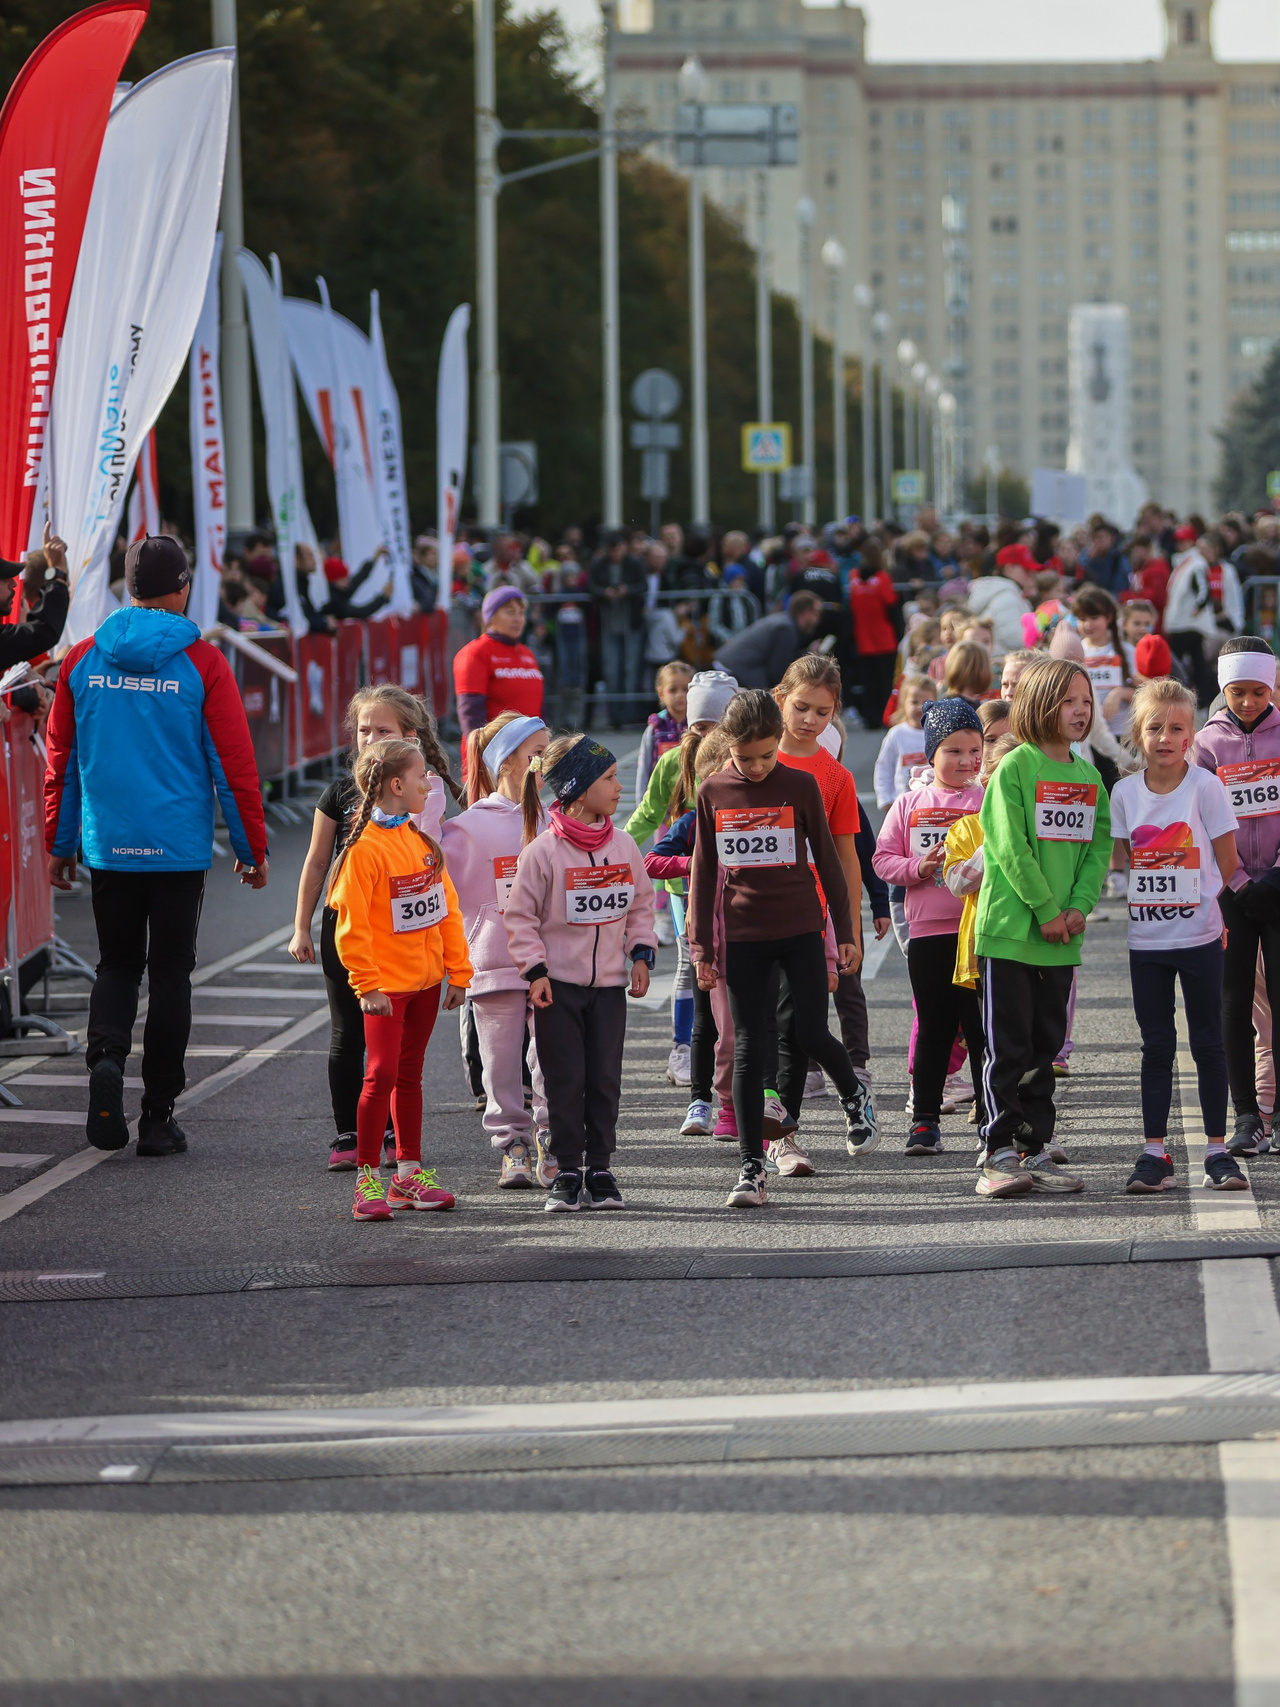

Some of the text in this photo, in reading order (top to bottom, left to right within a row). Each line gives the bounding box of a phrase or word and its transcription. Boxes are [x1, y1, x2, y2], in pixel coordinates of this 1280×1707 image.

[88, 675, 180, 694] RUSSIA
[1231, 785, 1279, 806] 3168
[1041, 810, 1084, 828] 3002
[724, 836, 778, 855] 3028
[920, 833, 947, 848] 31
[112, 847, 163, 855] NORDSKI
[1136, 876, 1176, 892] 3131
[401, 893, 440, 919] 3052
[575, 892, 628, 912] 3045
